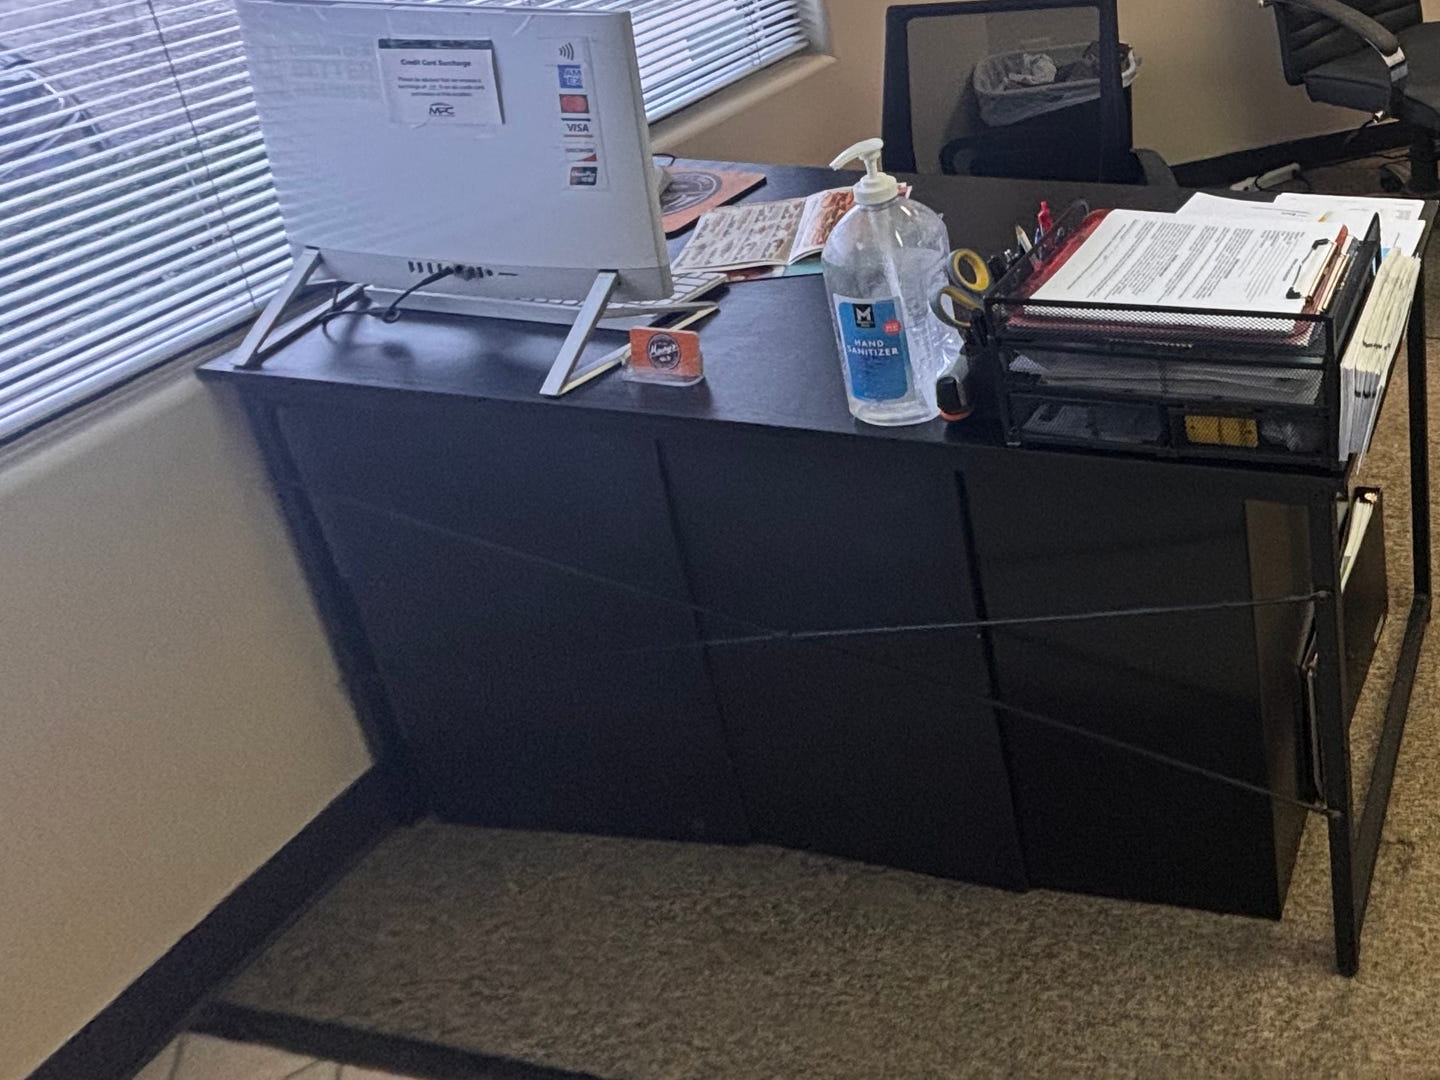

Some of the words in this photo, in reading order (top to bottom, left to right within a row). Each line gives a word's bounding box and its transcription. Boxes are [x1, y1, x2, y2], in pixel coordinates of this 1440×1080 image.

[567, 123, 590, 133] VISA
[854, 339, 884, 348] HAND
[847, 345, 900, 357] SANITIZER
